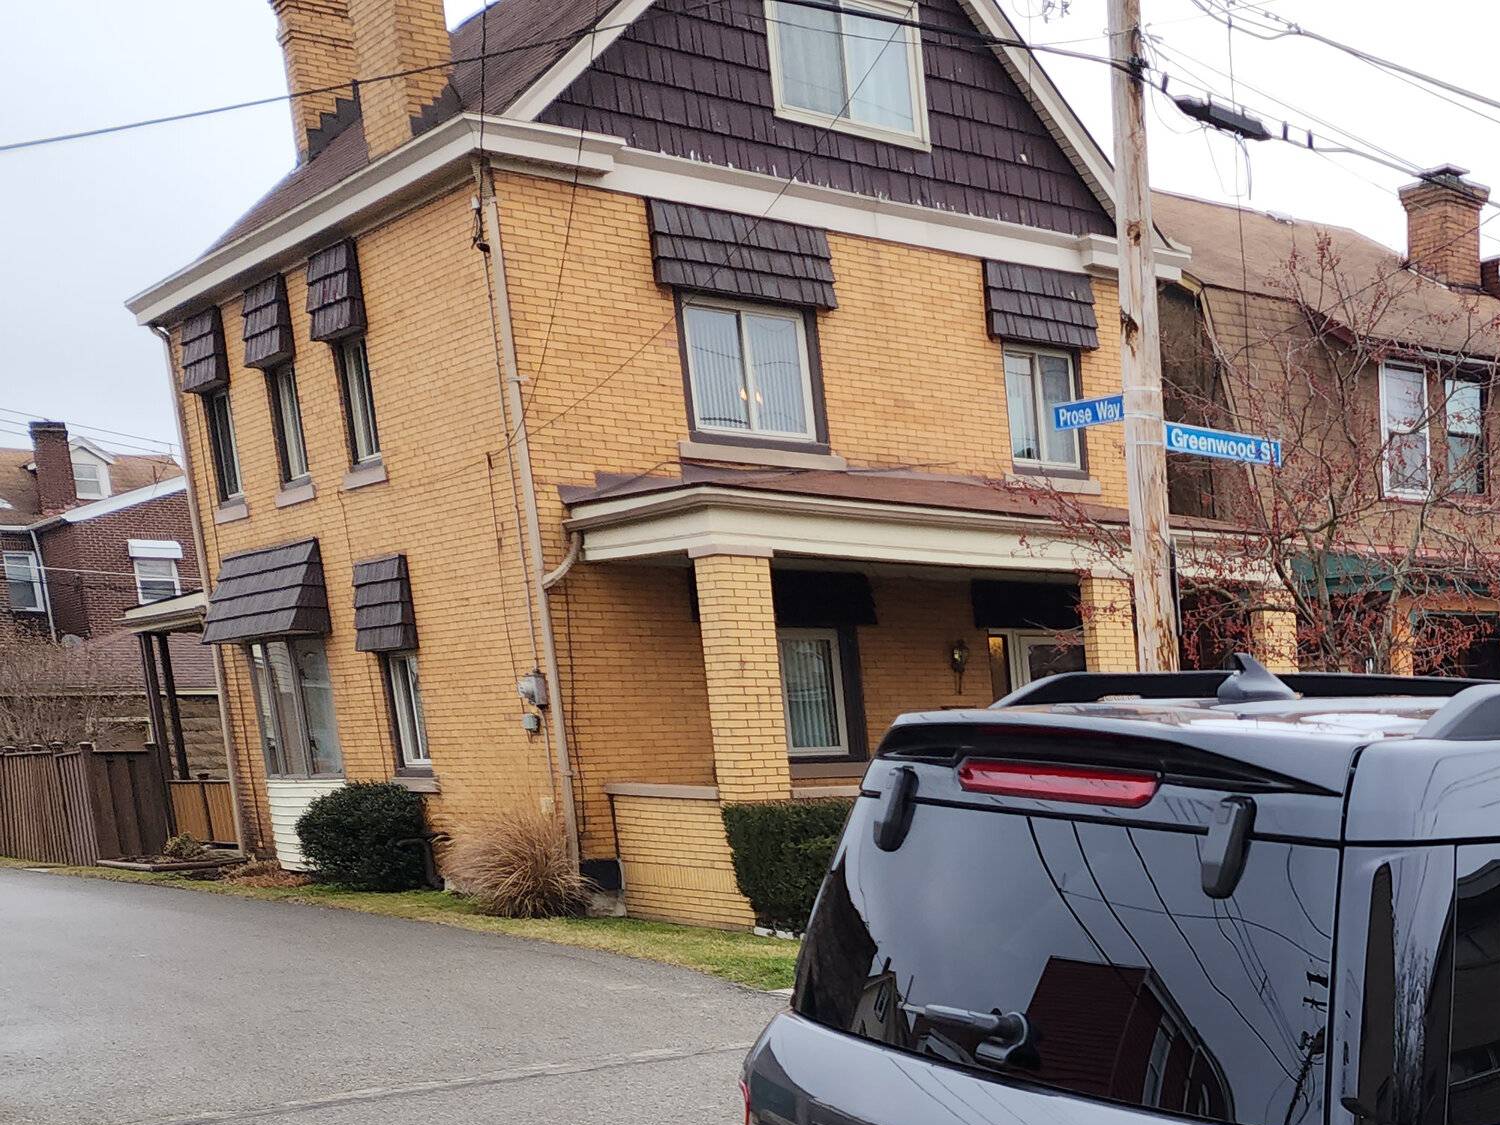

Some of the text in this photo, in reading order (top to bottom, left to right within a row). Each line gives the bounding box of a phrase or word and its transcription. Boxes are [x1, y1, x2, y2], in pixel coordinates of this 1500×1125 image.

[1058, 401, 1121, 427] Prose Way
[1171, 428, 1276, 463] Greenwood St
